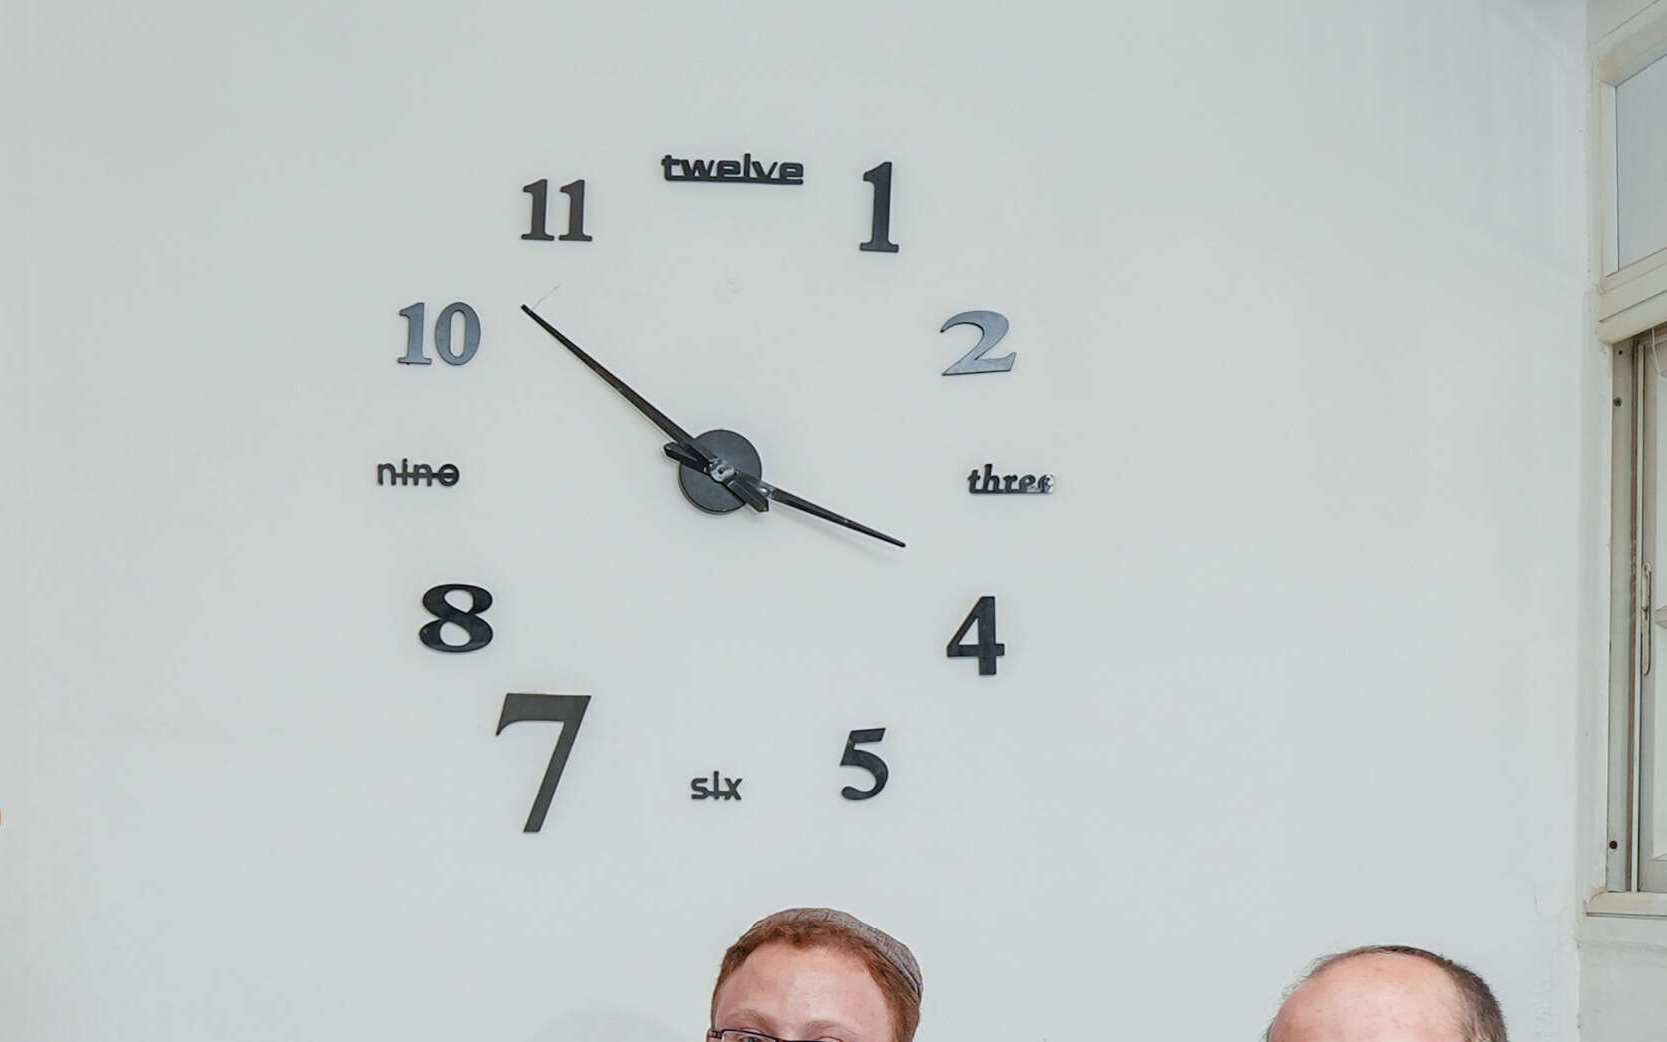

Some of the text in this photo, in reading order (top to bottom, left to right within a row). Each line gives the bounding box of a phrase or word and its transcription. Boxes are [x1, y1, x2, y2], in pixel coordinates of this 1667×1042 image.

[661, 153, 804, 185] twelve
[521, 179, 593, 242] 11
[859, 162, 899, 253] 1
[397, 302, 481, 366] 10
[940, 311, 1016, 376] 2
[967, 464, 1054, 494] three
[419, 584, 493, 653] 8
[946, 596, 1005, 676] 4
[496, 693, 591, 833] 7
[691, 771, 742, 800] six
[840, 728, 888, 801] 5
